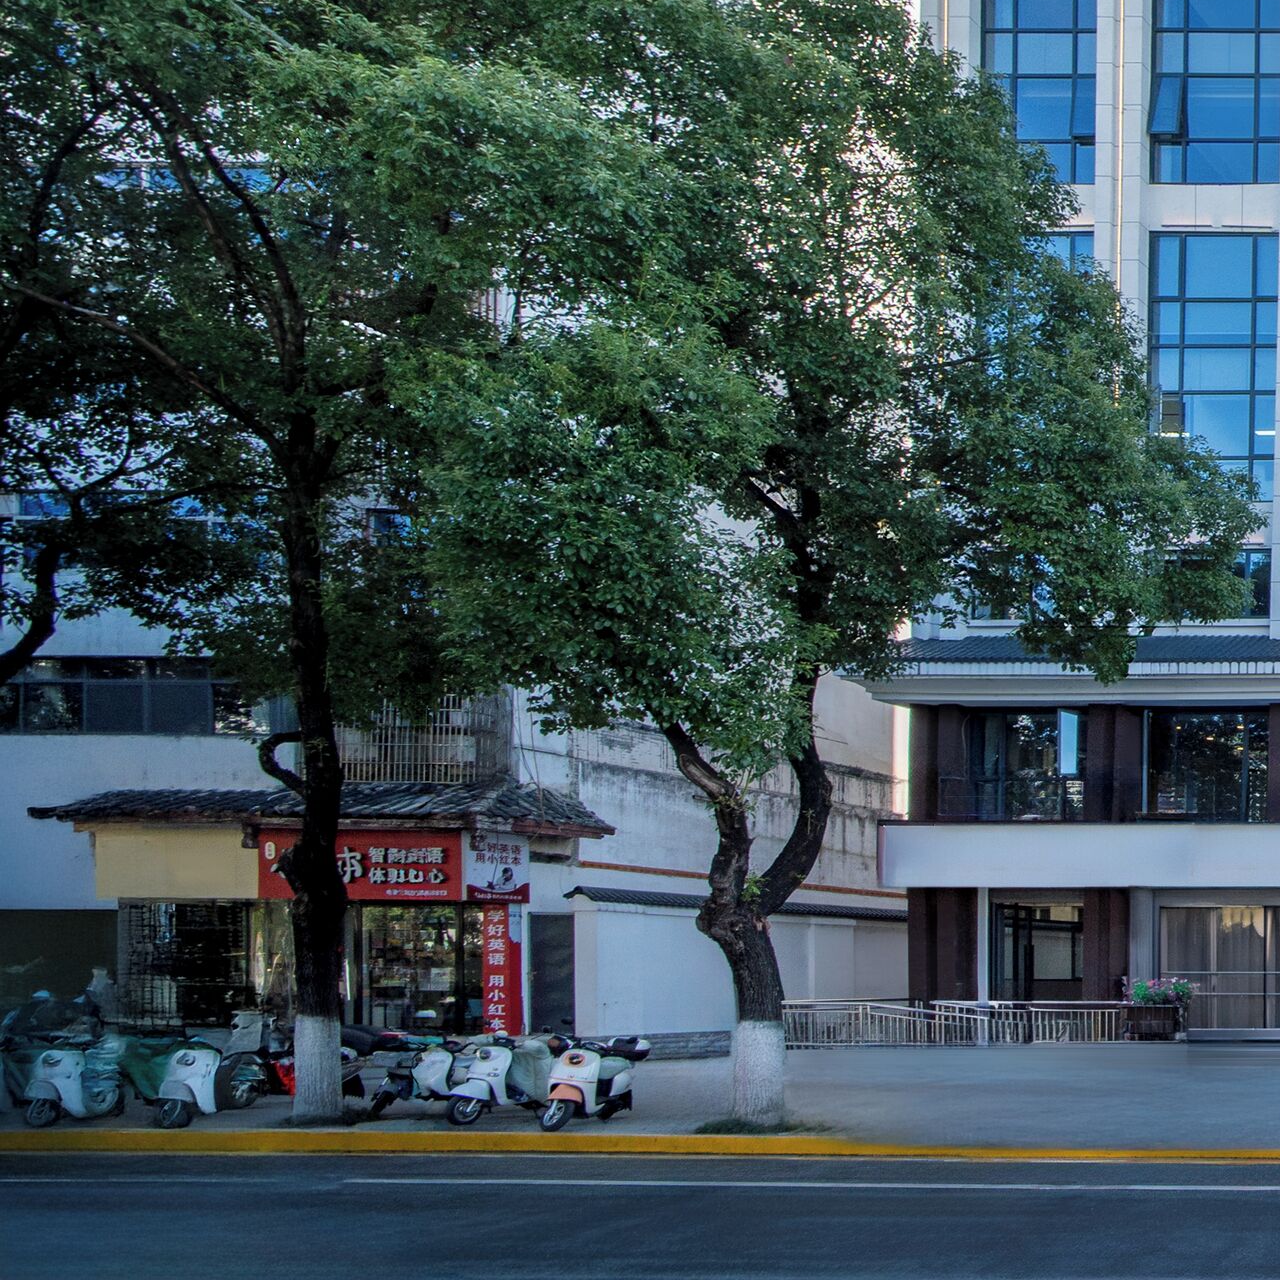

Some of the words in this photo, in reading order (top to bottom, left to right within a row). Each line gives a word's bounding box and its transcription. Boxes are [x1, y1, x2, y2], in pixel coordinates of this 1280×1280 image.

[487, 909, 506, 966] 学好英语
[487, 974, 506, 1031] 用小红本
